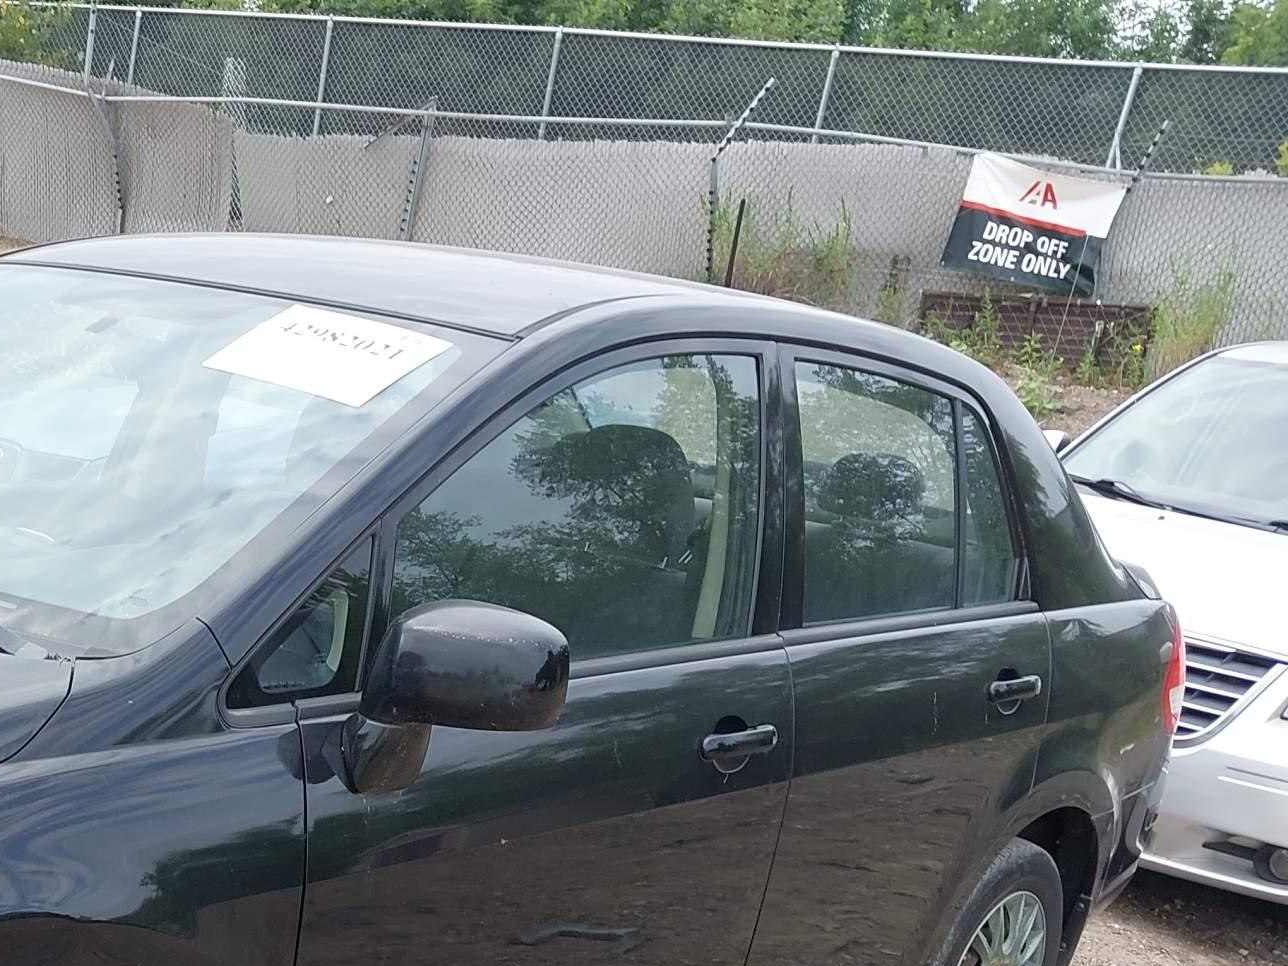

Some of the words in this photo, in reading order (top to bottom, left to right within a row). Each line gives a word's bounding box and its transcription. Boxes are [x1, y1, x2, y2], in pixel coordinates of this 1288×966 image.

[982, 220, 1033, 248] DROP
[1036, 235, 1069, 259] OFF
[967, 240, 1020, 269] ZONE
[1021, 252, 1071, 280] ONLY
